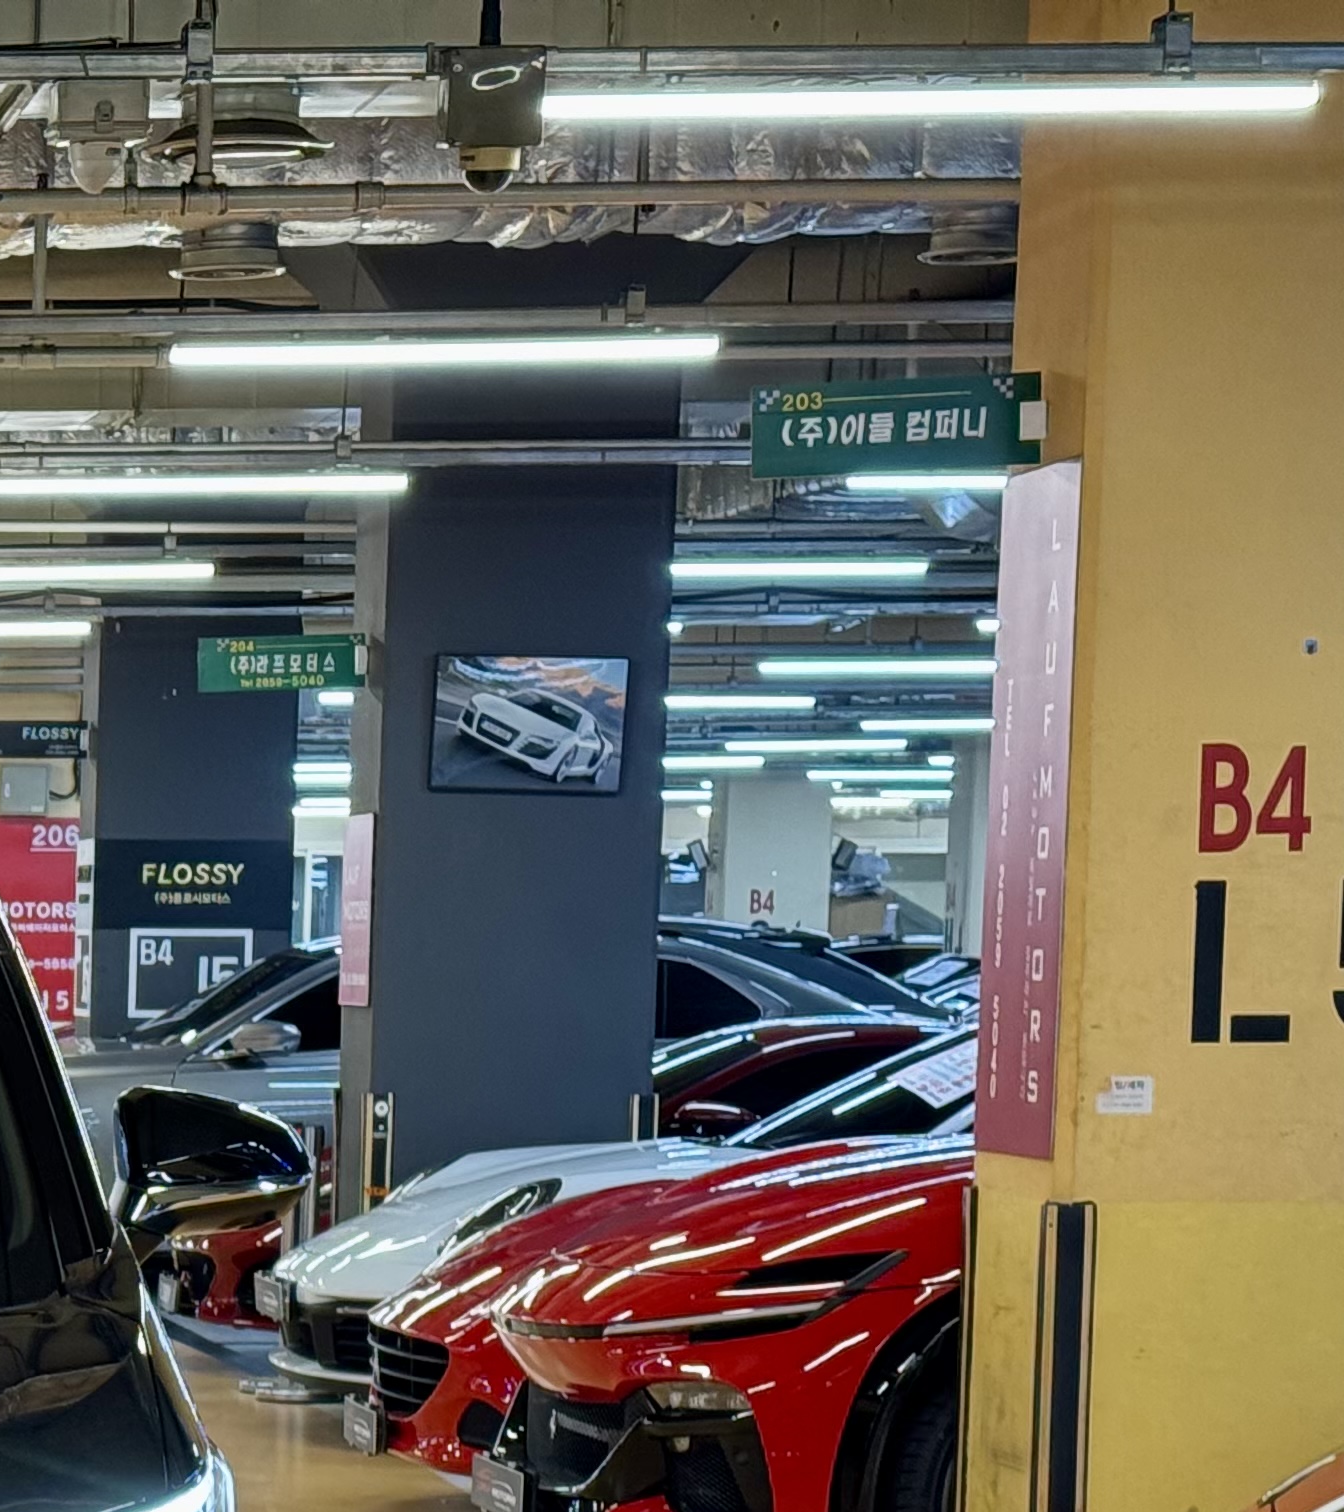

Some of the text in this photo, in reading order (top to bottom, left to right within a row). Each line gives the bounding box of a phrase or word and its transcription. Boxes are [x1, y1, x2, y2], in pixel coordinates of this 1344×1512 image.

[781, 392, 823, 412] 203
[905, 406, 988, 441] 컴퍼니
[229, 640, 255, 653] 204
[22, 726, 79, 740] FLOSSY
[1198, 743, 1312, 853] B4
[32, 824, 79, 846] 206
[142, 862, 245, 886] FLOSSY
[749, 888, 775, 916] B4
[140, 938, 174, 966] B4
[1191, 878, 1344, 1043] L
